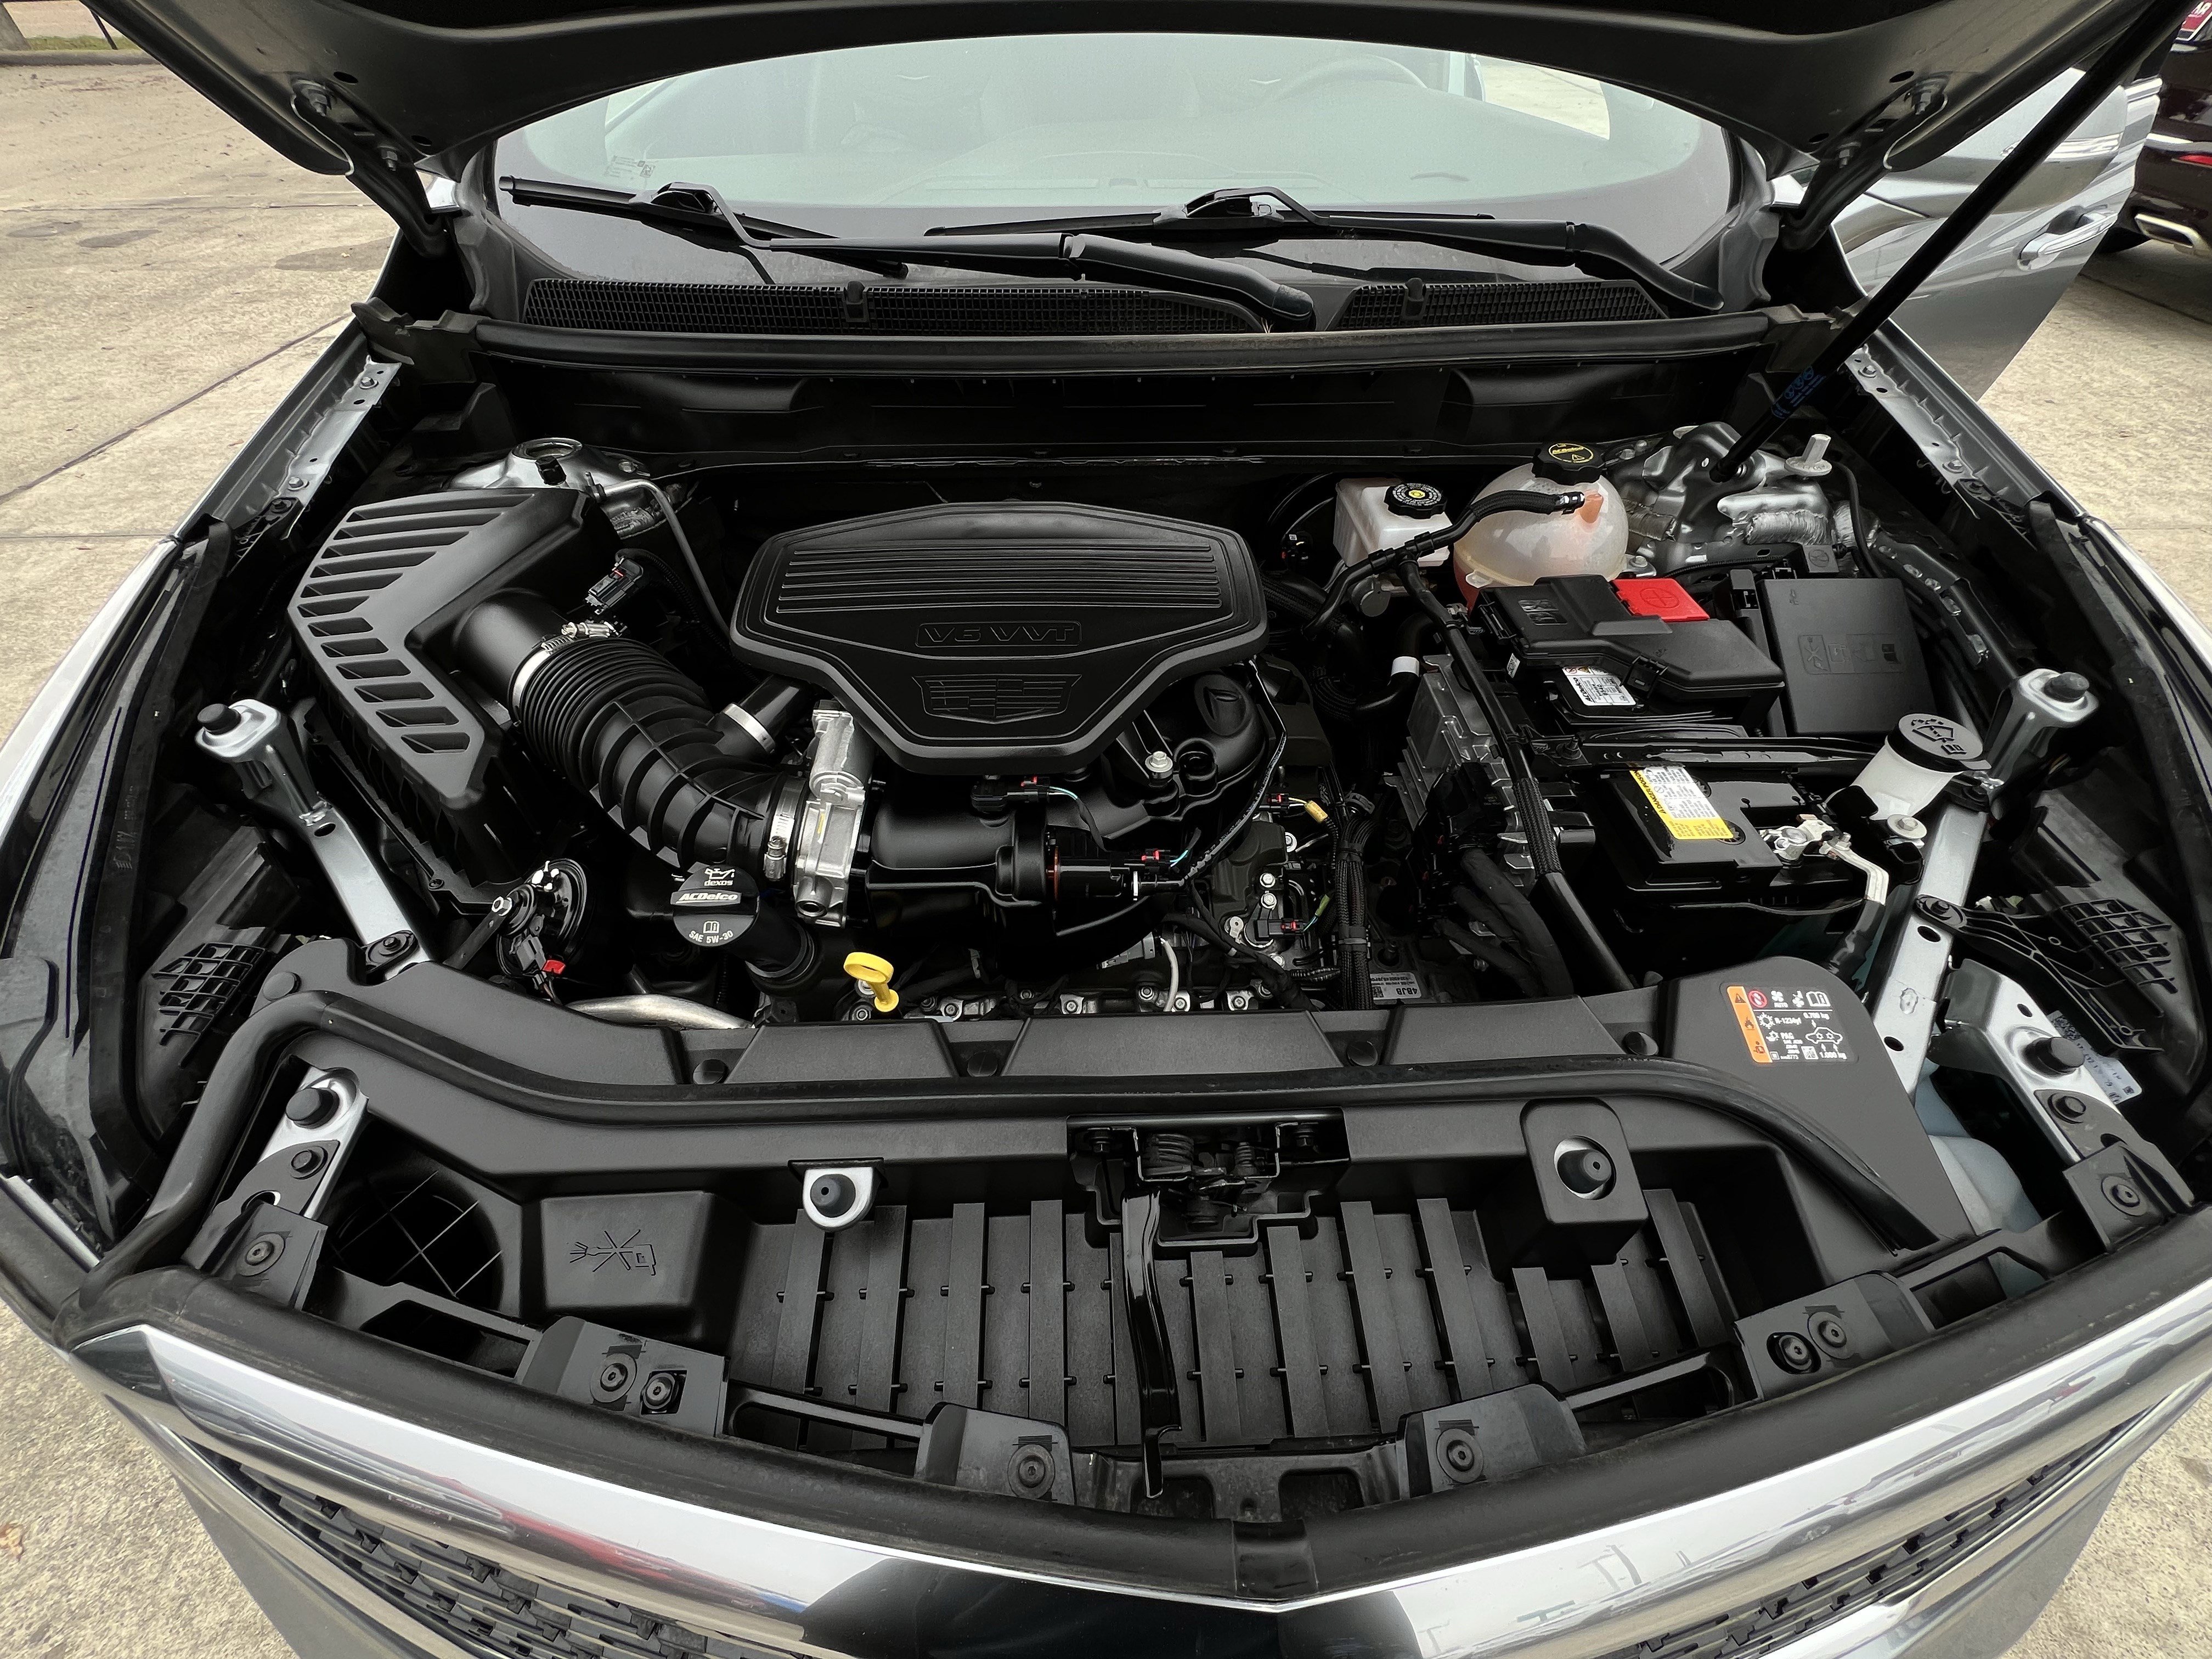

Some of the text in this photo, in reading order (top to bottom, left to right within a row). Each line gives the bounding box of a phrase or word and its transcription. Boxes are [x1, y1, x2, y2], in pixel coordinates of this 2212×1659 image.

[924, 625, 1074, 642] V6 VVT
[678, 892, 738, 901] ACDelco
[689, 930, 733, 944] SAE 5W-30
